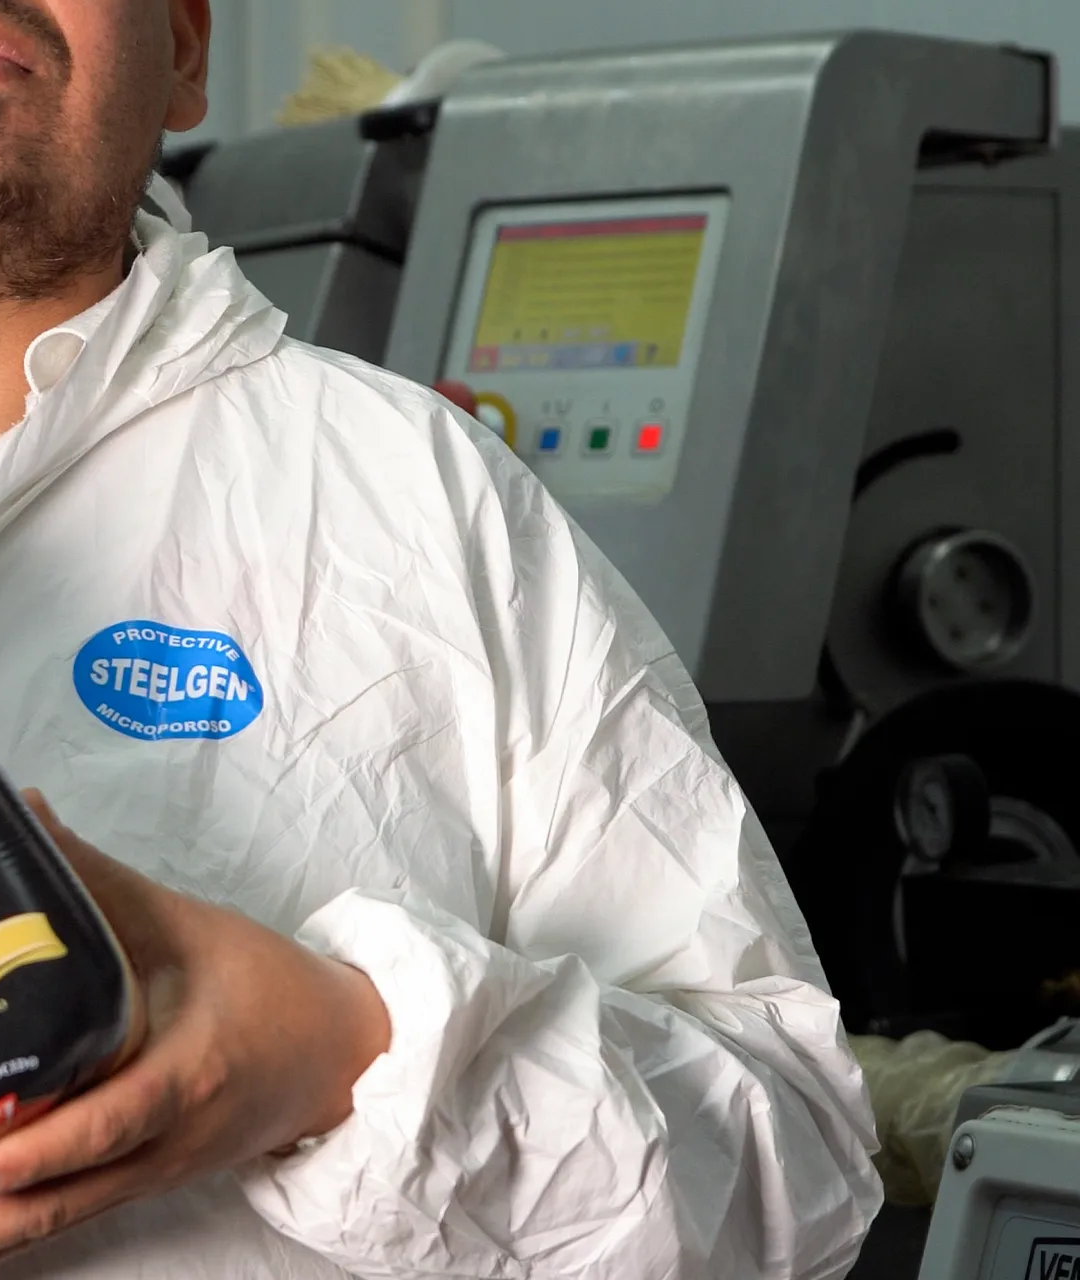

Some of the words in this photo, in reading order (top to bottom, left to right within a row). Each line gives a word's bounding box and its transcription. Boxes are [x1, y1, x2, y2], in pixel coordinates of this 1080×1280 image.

[112, 628, 240, 662] PROTECTIVE
[90, 658, 248, 702] STEELGEN
[96, 703, 231, 735] MICROPOROSO
